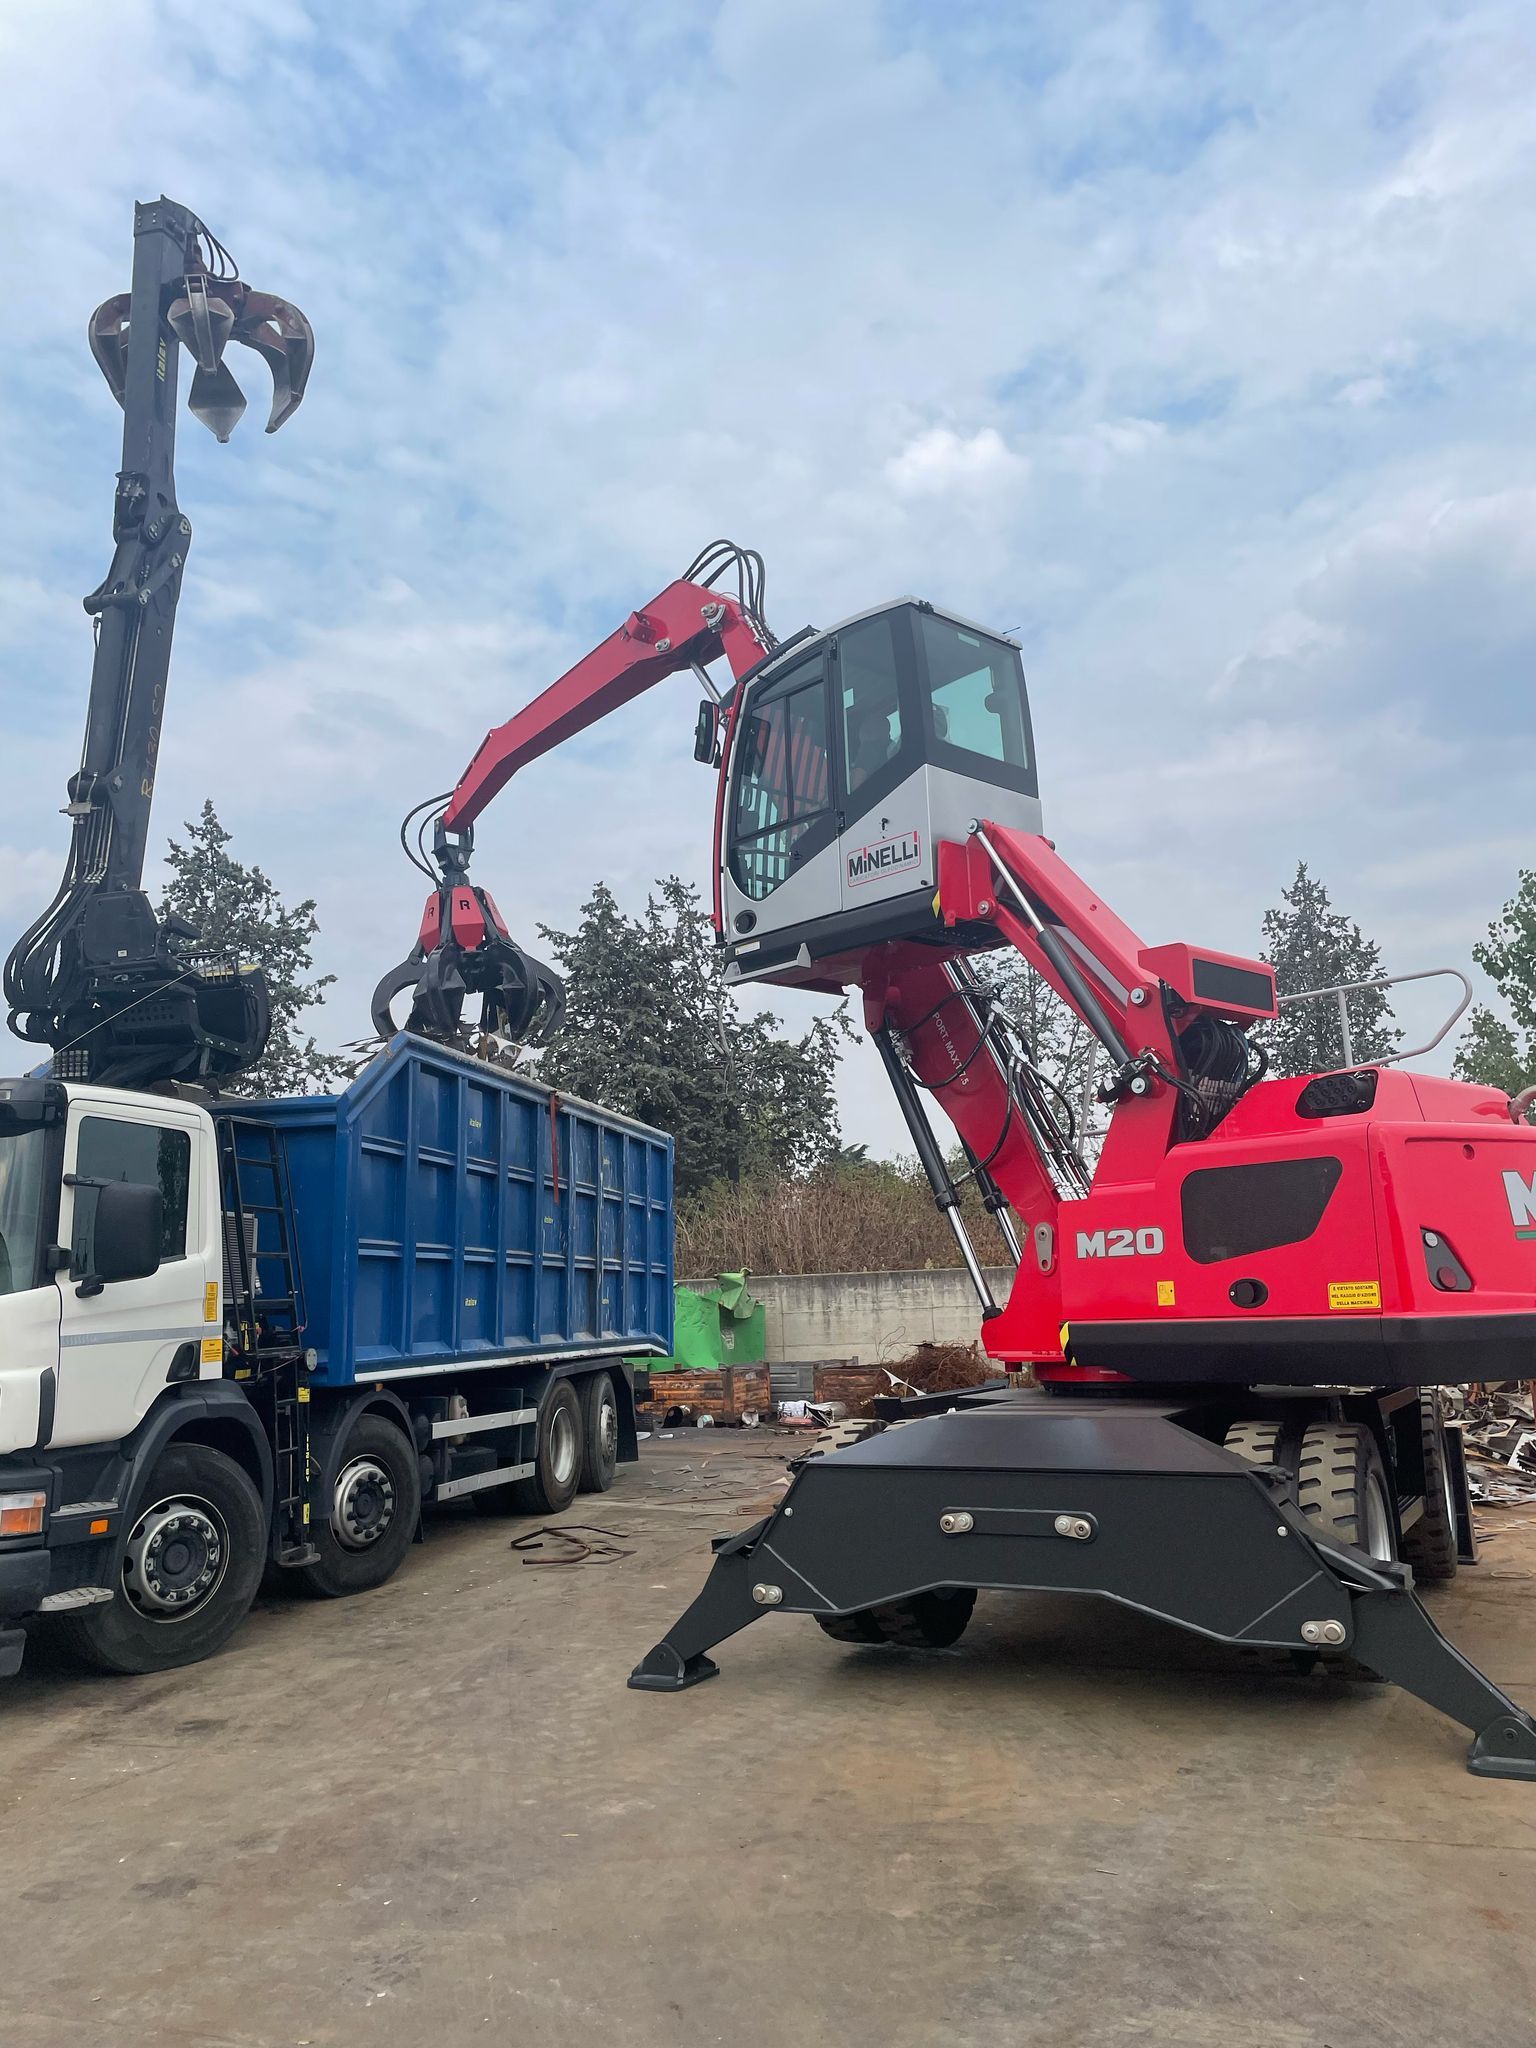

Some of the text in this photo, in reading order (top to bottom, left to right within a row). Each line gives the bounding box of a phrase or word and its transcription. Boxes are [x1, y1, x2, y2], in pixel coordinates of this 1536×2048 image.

[459, 899, 471, 911] R
[945, 1040, 960, 1065] MAX
[1075, 1226, 1165, 1259] M20
